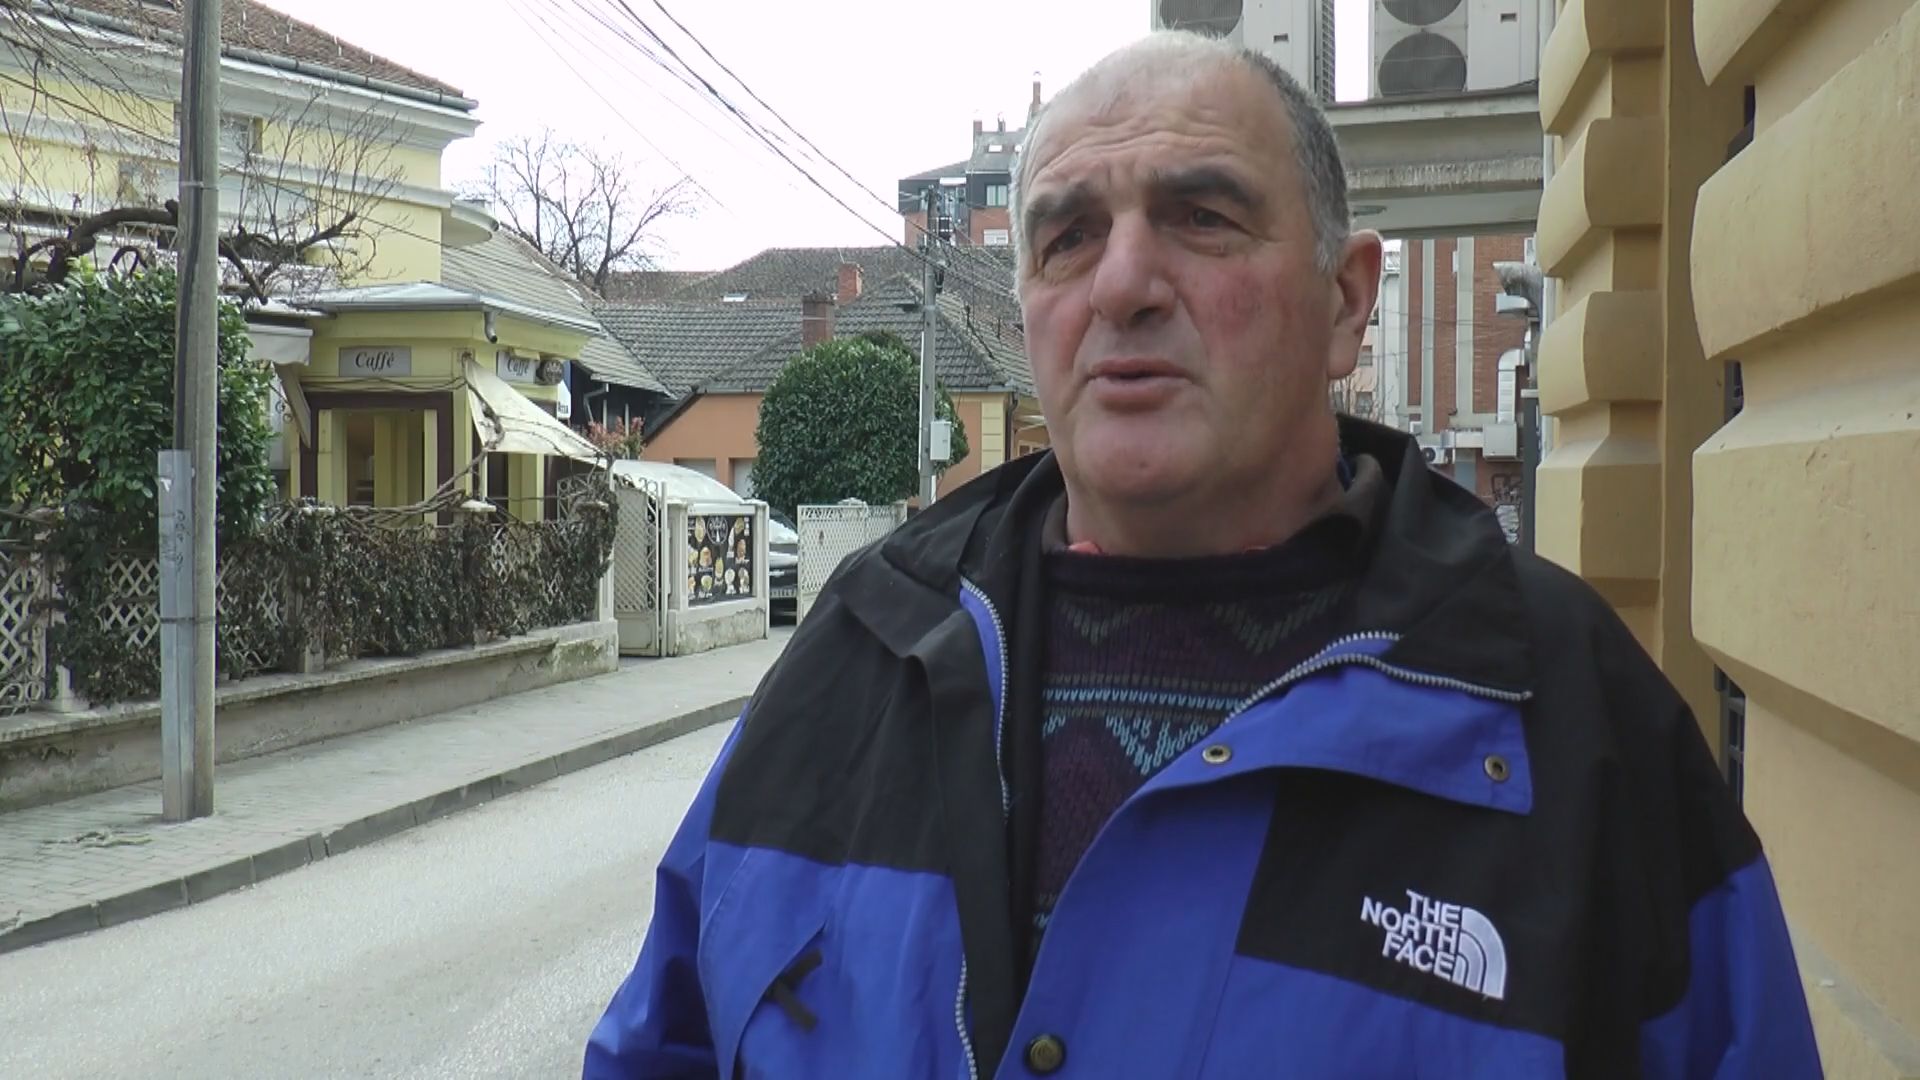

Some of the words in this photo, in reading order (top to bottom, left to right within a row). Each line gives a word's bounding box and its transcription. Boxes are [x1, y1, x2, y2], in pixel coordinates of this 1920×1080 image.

[1360, 896, 1459, 954] NORTH
[1406, 889, 1461, 929] THE
[1382, 931, 1456, 981] FACE
